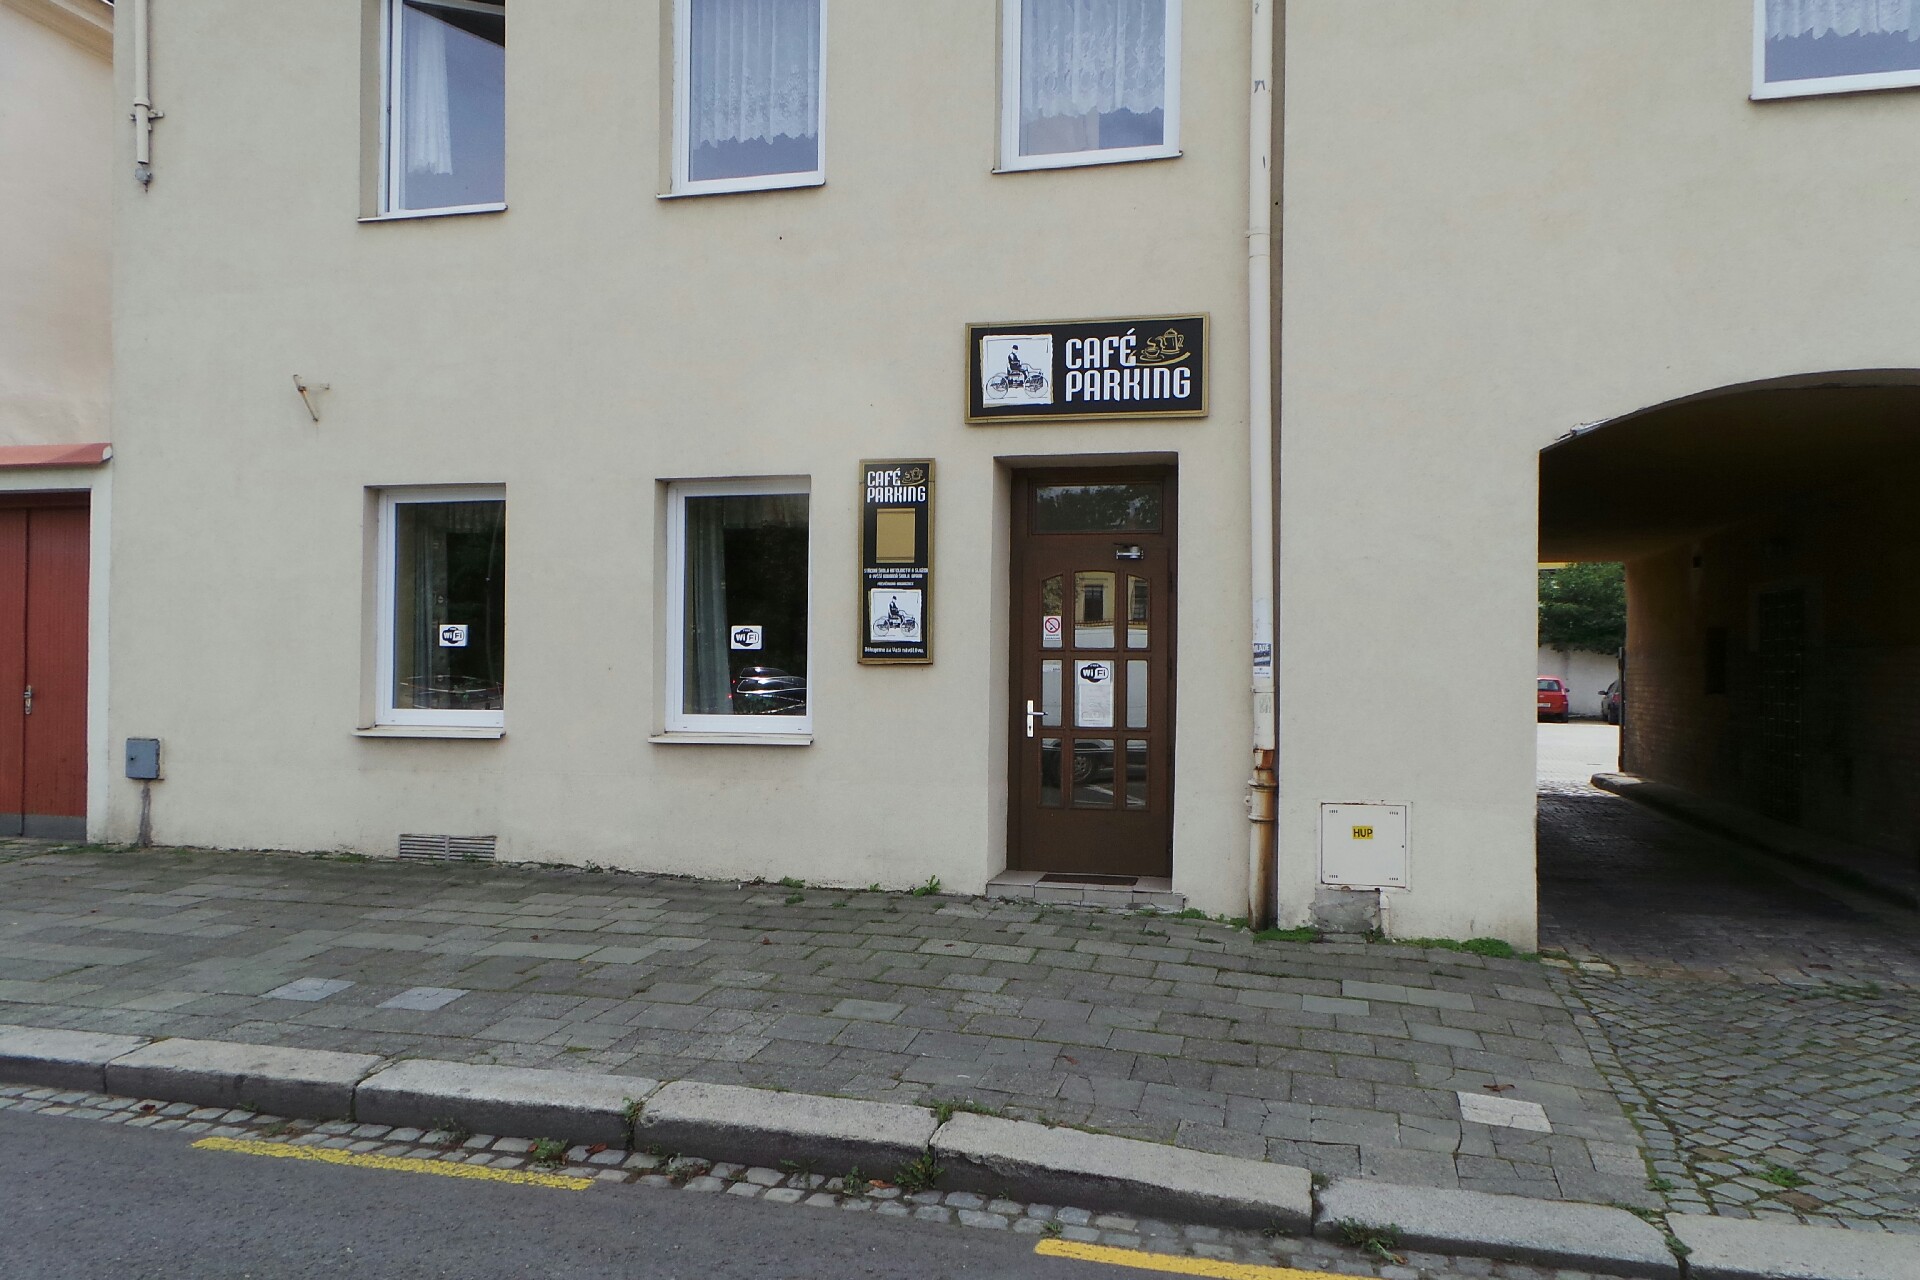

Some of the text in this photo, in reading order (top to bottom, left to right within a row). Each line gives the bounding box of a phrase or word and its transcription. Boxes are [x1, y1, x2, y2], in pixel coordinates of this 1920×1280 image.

[1065, 327, 1136, 369] CAFÉ
[1065, 367, 1191, 401] PARKING
[867, 467, 900, 487] CAFÉ
[867, 486, 926, 503] PARKING
[1353, 828, 1373, 838] HUP
